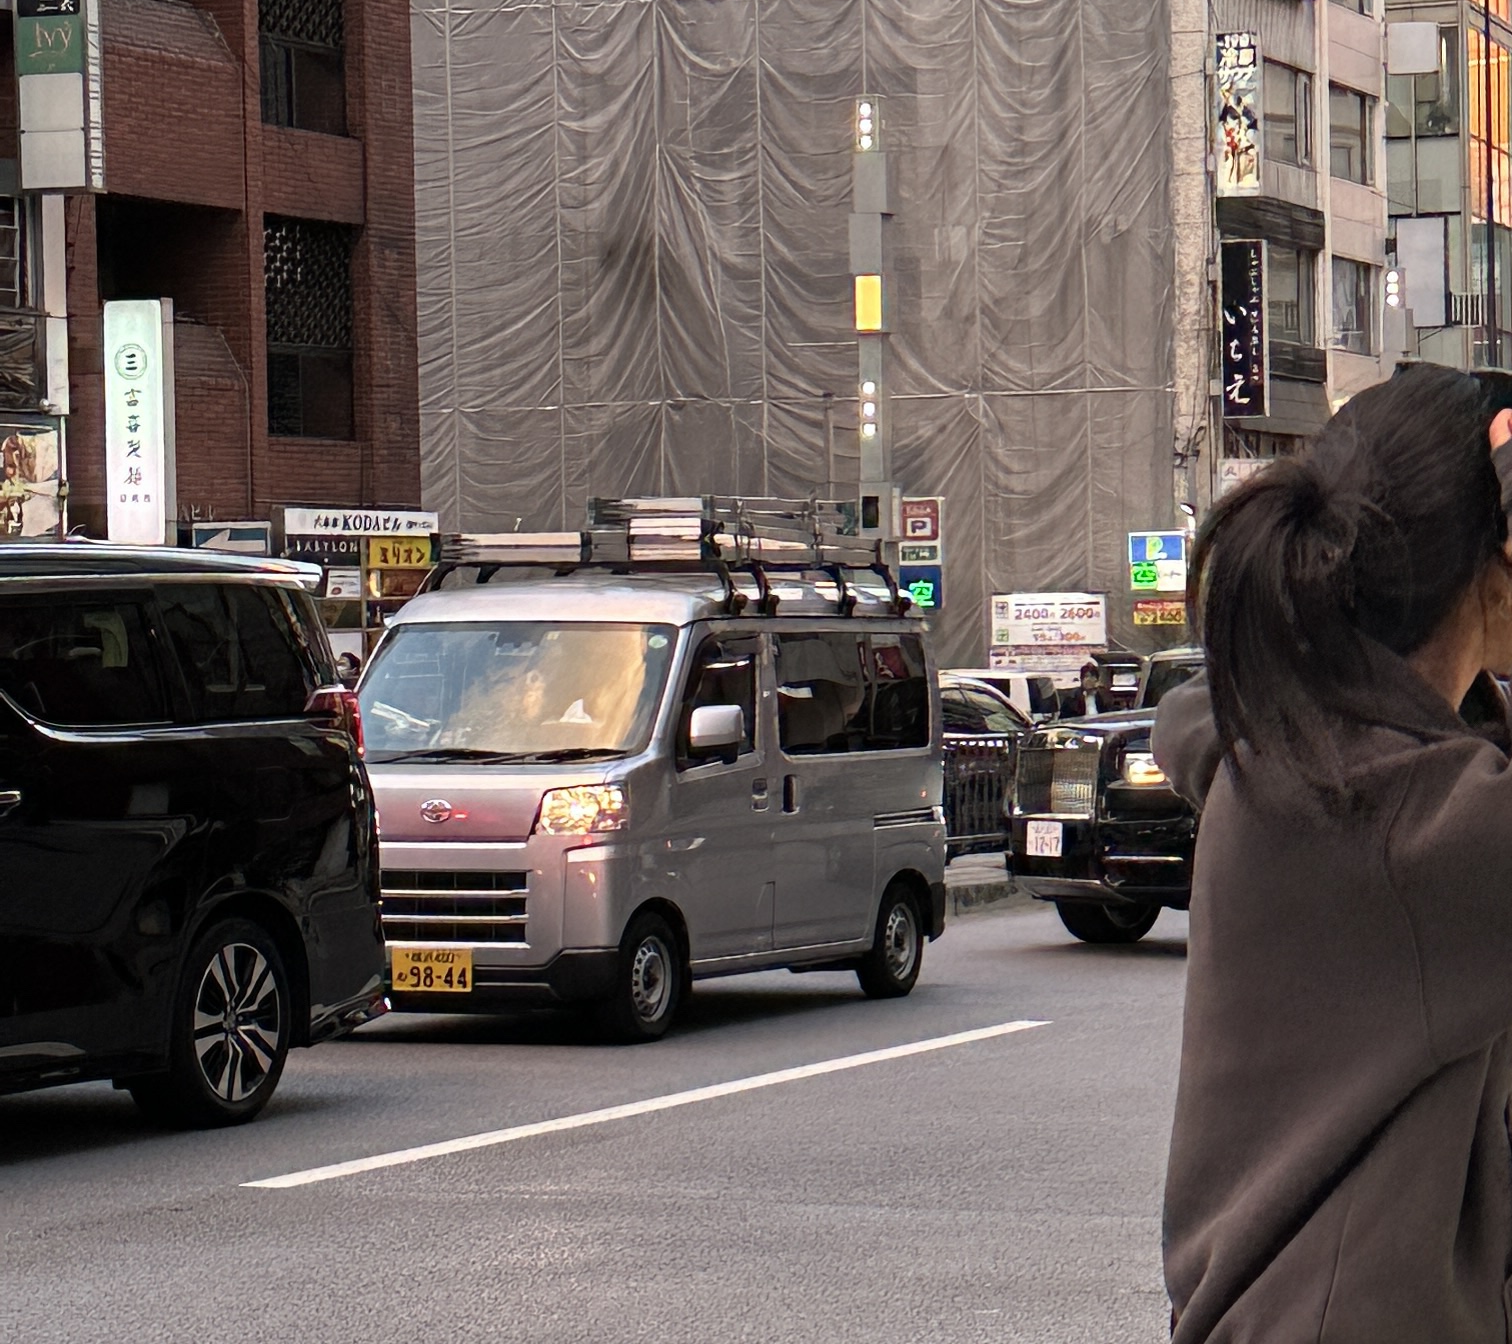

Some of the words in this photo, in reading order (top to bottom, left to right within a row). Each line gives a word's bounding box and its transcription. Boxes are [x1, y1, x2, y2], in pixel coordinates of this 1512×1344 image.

[1223, 306, 1251, 404] いちえ
[908, 580, 935, 606] 空
[410, 966, 467, 989] 98-44
